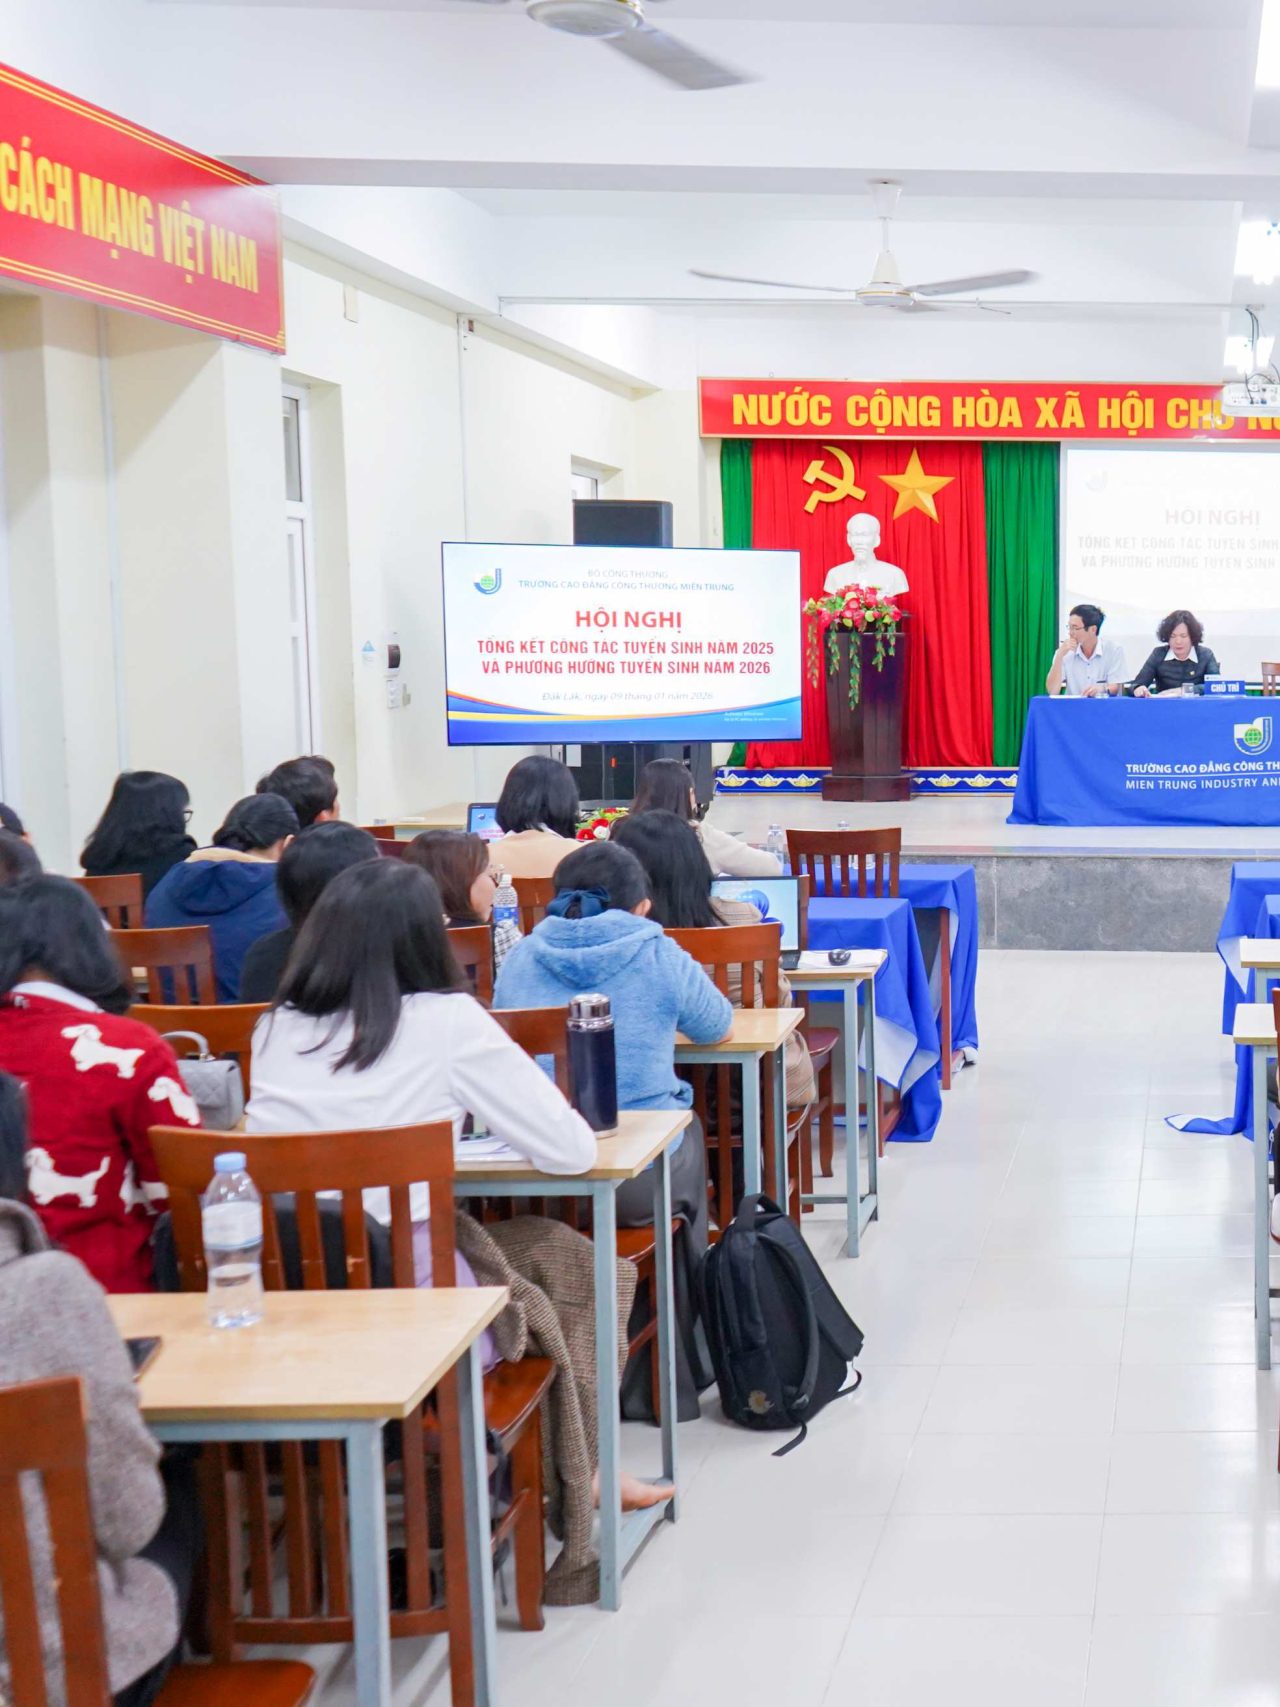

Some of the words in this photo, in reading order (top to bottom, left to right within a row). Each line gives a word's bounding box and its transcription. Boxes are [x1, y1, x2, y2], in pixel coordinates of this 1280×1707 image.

[0, 135, 75, 232] CÁCH
[80, 172, 156, 259] MẠNG
[158, 200, 205, 284] VIỆT
[210, 223, 259, 293] NAM
[733, 386, 832, 427] NƯỚC
[847, 388, 941, 434] CỘNG
[953, 389, 1023, 428] HÒA
[1035, 391, 1085, 429] XÃ
[1098, 390, 1154, 435] HỘI
[575, 606, 616, 633] HỘI
[624, 611, 681, 634] NGHỊ
[671, 641, 702, 654] SINH
[742, 642, 774, 655] 2025
[667, 661, 699, 674] SINH
[739, 661, 771, 674] 2026
[1174, 764, 1197, 773] CAO
[1233, 760, 1264, 772] CÔNG
[1126, 780, 1154, 789] MIEN
[1158, 780, 1197, 790] TRUNG
[1201, 778, 1258, 789] INDUSTRY
